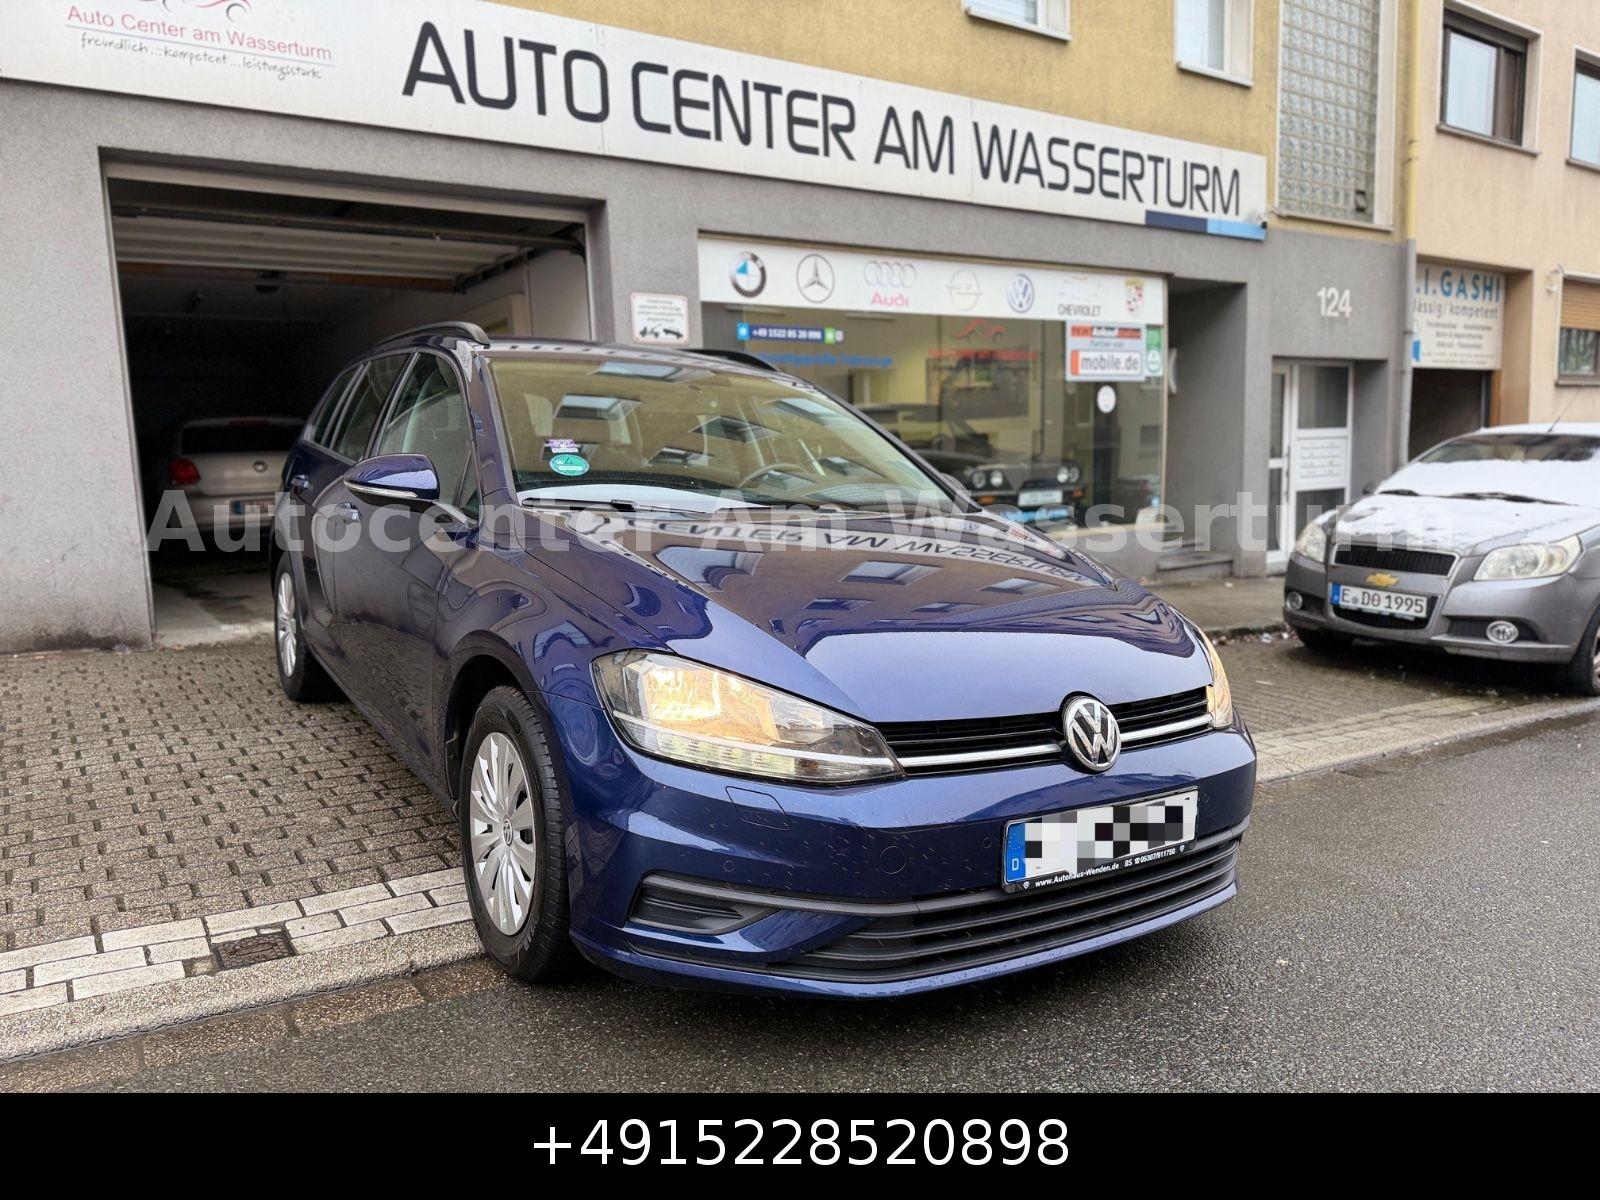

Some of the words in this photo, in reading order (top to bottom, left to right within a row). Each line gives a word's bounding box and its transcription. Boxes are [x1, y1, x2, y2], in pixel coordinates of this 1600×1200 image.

[67, 5, 115, 28] Auto
[121, 13, 187, 38] Center
[192, 29, 221, 43] am
[226, 30, 332, 60] Wasserturm
[81, 32, 149, 53] freundlich
[402, 20, 609, 123] AUTO
[631, 61, 856, 162] CENTER
[873, 105, 955, 176] AM
[972, 119, 1241, 216] WASSERTURM
[870, 291, 910, 308] Audi
[1057, 303, 1102, 317] CHEVROLET
[1317, 286, 1352, 318] 124
[1081, 353, 1139, 372] mobile.de
[1341, 588, 1350, 604] E
[1384, 594, 1425, 614] 1995
[1011, 857, 1020, 871] D
[1035, 861, 1120, 888] www.Autohaus-Wenden.de
